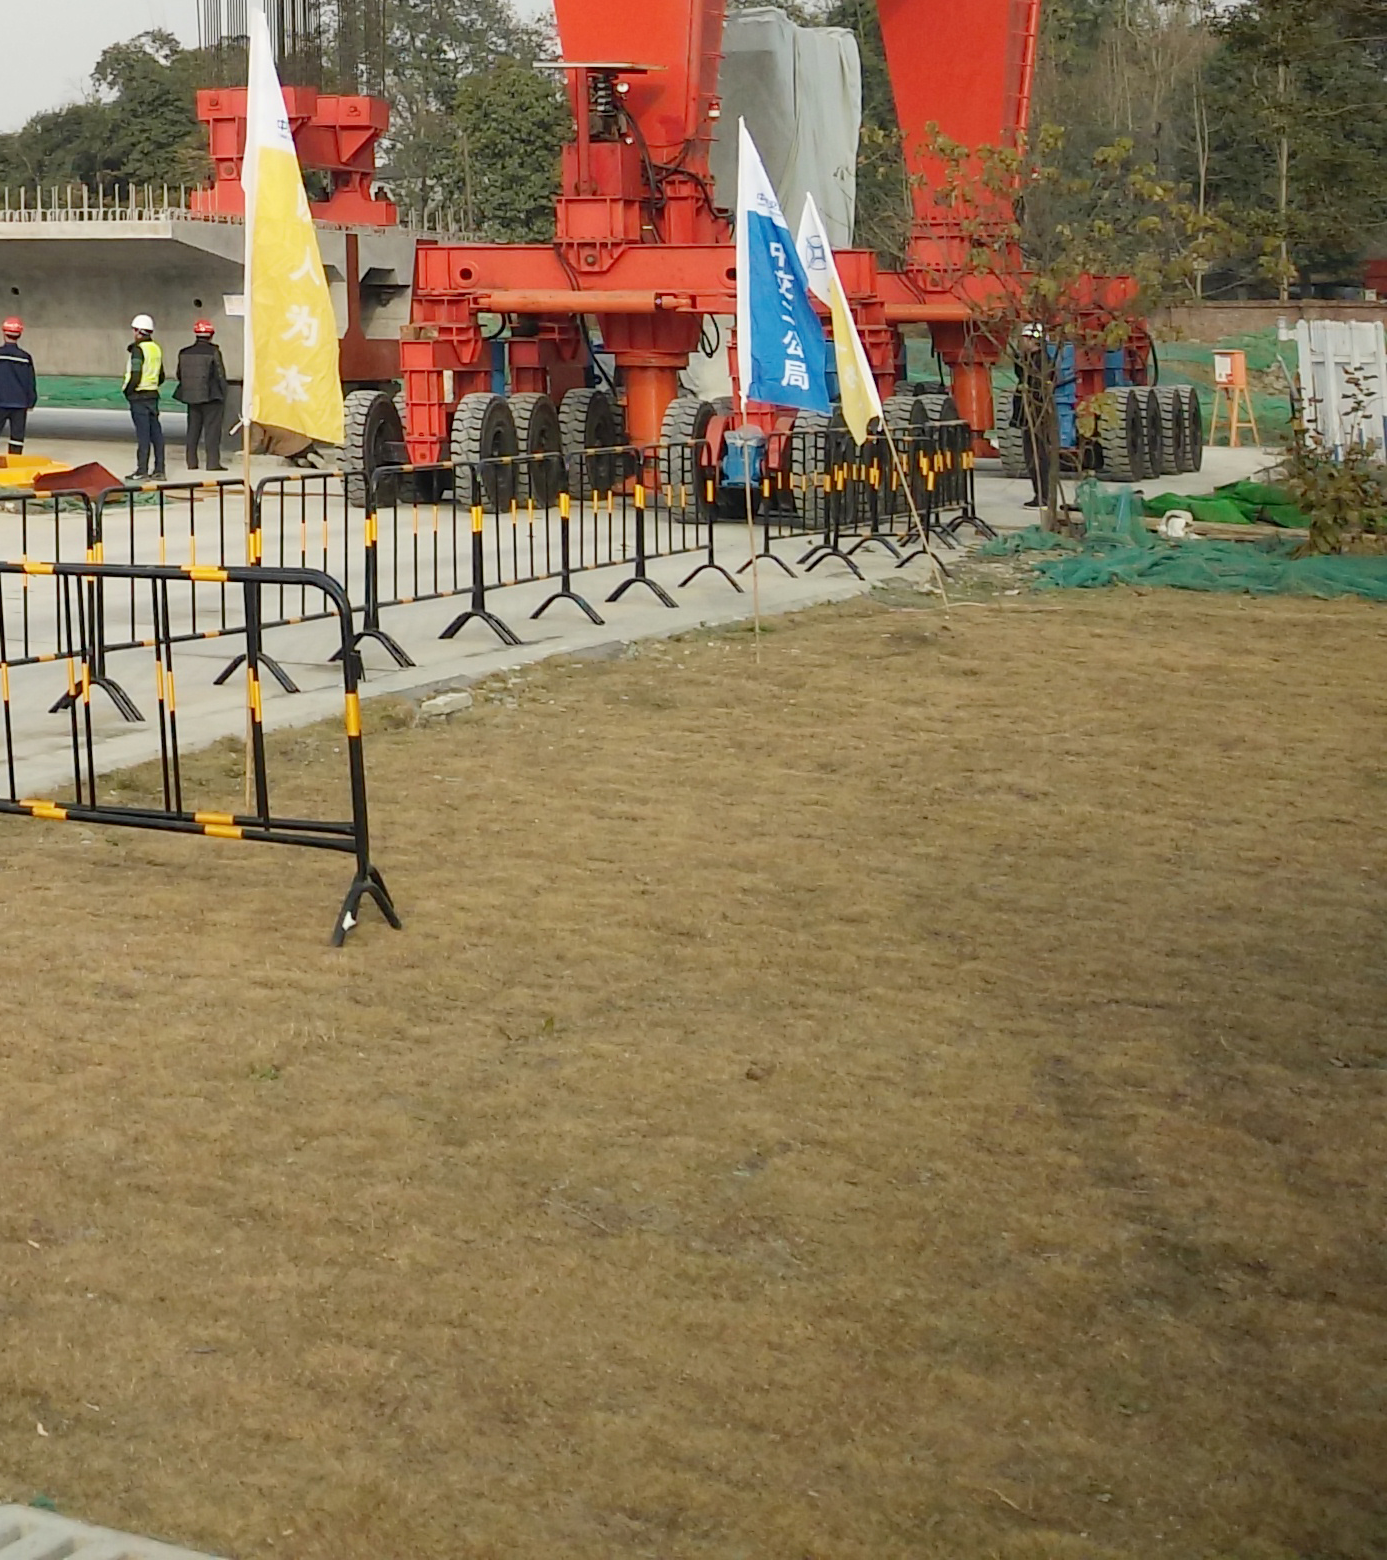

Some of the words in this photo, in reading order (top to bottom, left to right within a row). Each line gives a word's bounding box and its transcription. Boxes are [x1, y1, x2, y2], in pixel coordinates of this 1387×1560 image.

[769, 241, 810, 391] 中交二公局
